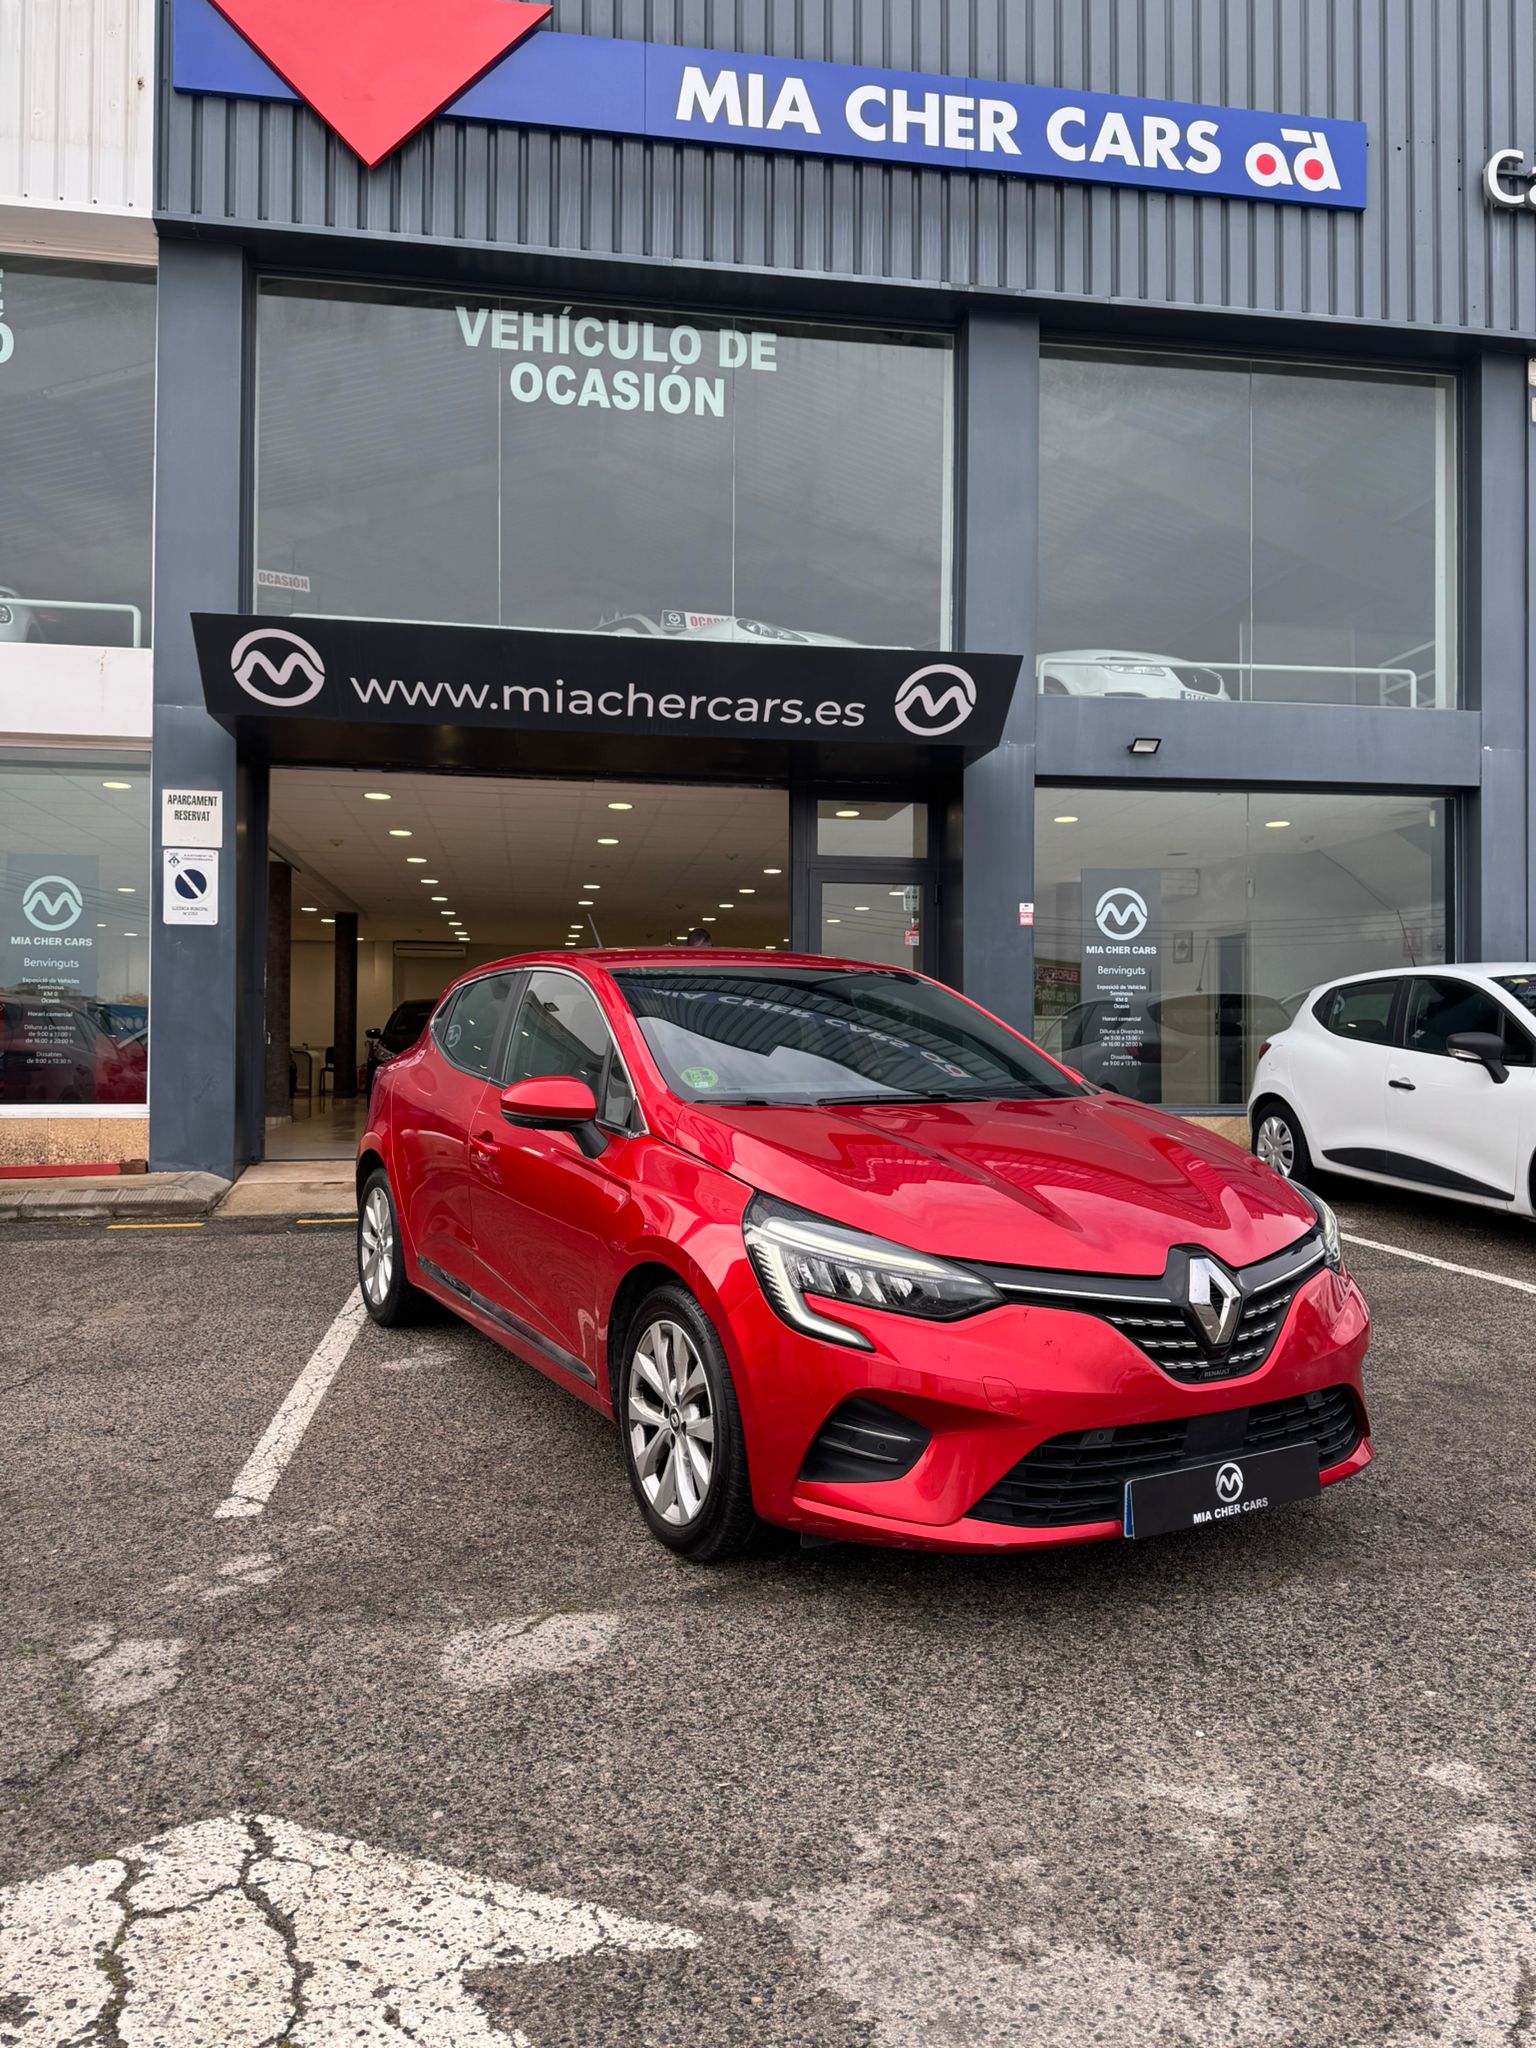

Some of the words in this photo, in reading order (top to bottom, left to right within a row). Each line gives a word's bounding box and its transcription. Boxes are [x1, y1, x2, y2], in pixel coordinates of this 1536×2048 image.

[675, 66, 822, 135] MIA
[845, 85, 1022, 155] CHER
[1046, 106, 1222, 174] CARS
[456, 306, 702, 367] VEHÍCULO
[718, 329, 778, 372] DE
[510, 362, 726, 418] OCASIÓN
[258, 571, 309, 590] OCASIÓN
[350, 676, 866, 727] www.miachercars.es
[167, 794, 218, 807] APARCAMENT
[174, 810, 210, 822] RESERVAT
[11, 936, 32, 945] MIA
[33, 936, 62, 946] CHER
[64, 937, 93, 947] CARS
[1086, 945, 1105, 954] MIA
[1105, 945, 1131, 955] CHER
[1131, 946, 1157, 955] CARS
[23, 957, 80, 970] Benvinguts
[1097, 965, 1146, 978] Benvinguts
[1204, 1368, 1230, 1377] RENAULT
[1193, 1510, 1213, 1525] MIA
[1214, 1504, 1241, 1519] CHER
[1243, 1497, 1269, 1513] CARS
